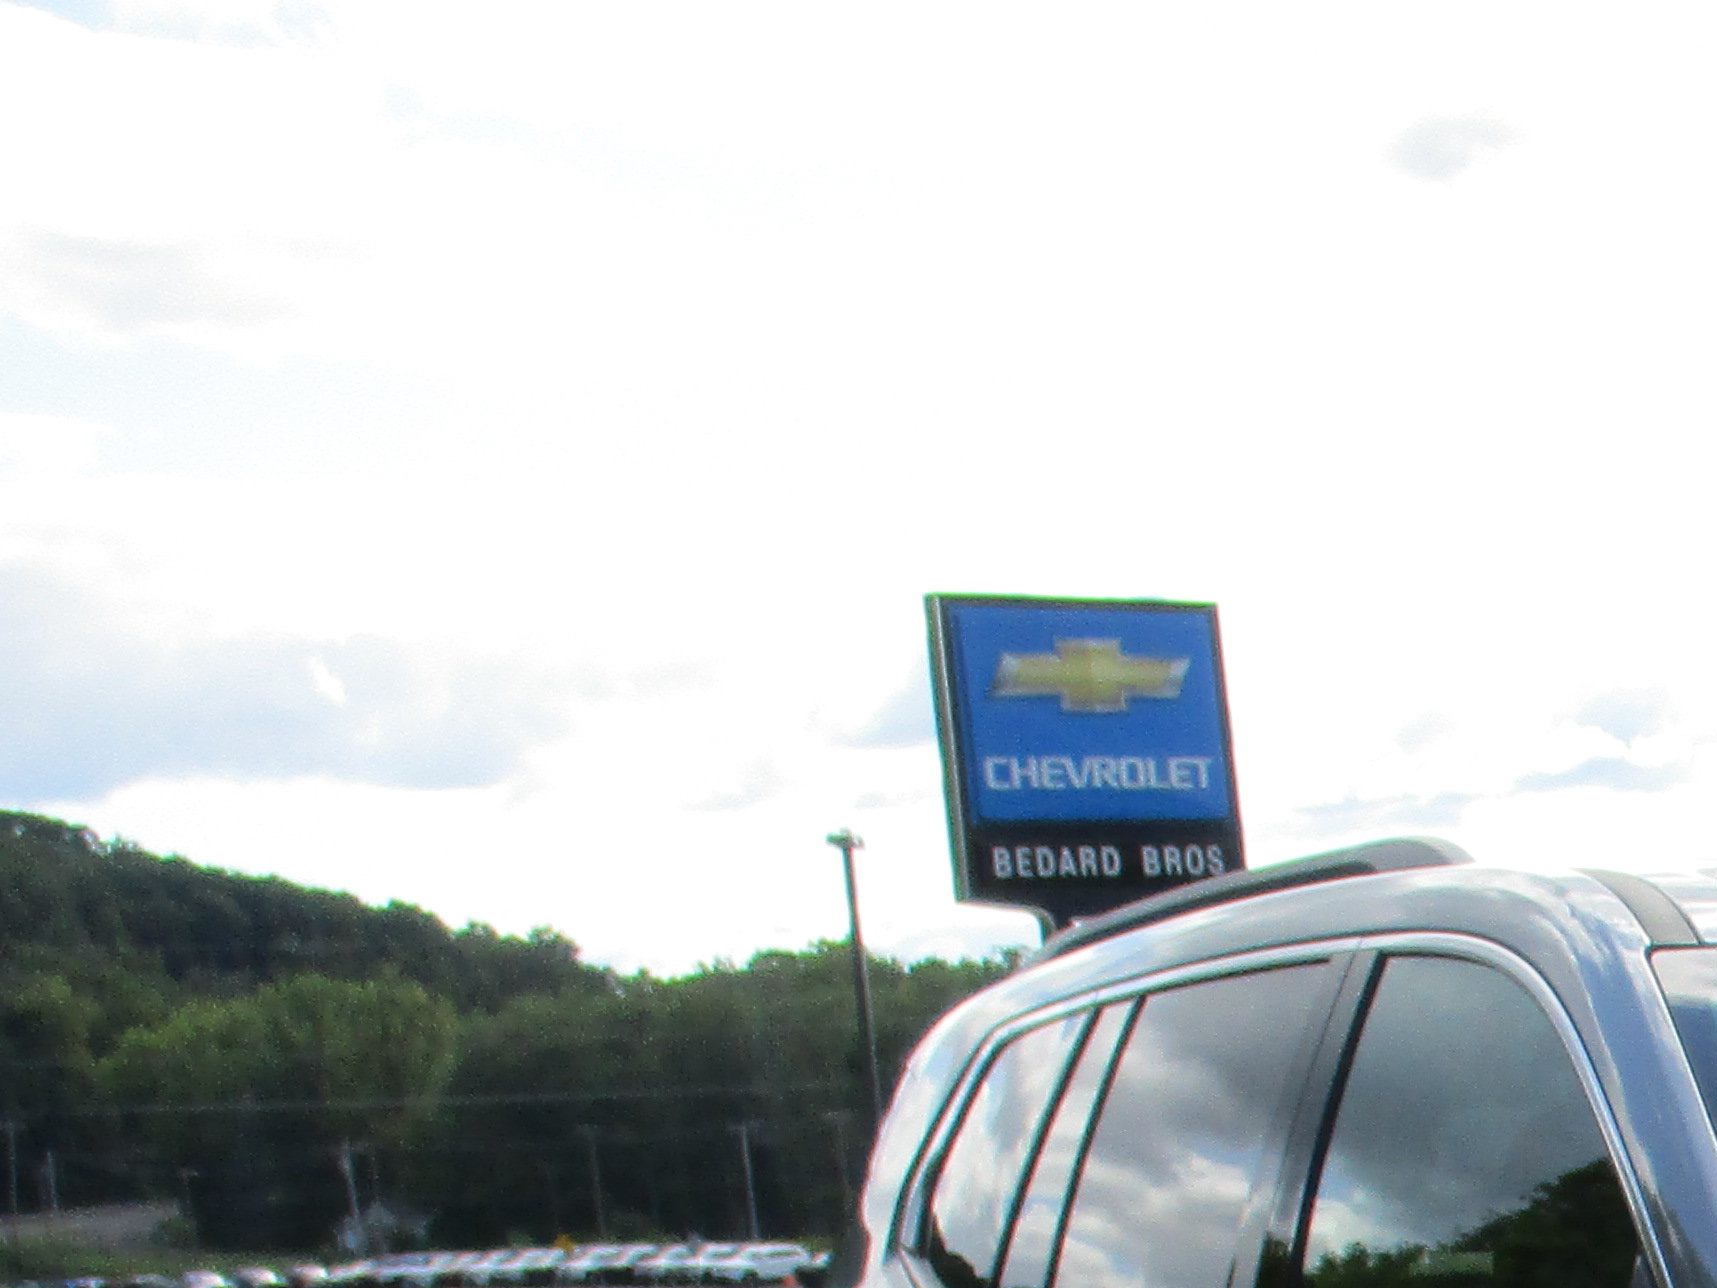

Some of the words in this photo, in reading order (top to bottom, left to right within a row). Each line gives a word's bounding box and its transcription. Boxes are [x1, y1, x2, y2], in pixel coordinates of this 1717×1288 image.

[983, 755, 1213, 790] CHEVROLET
[991, 844, 1122, 880] BEDARD
[1141, 843, 1228, 876] BROS
